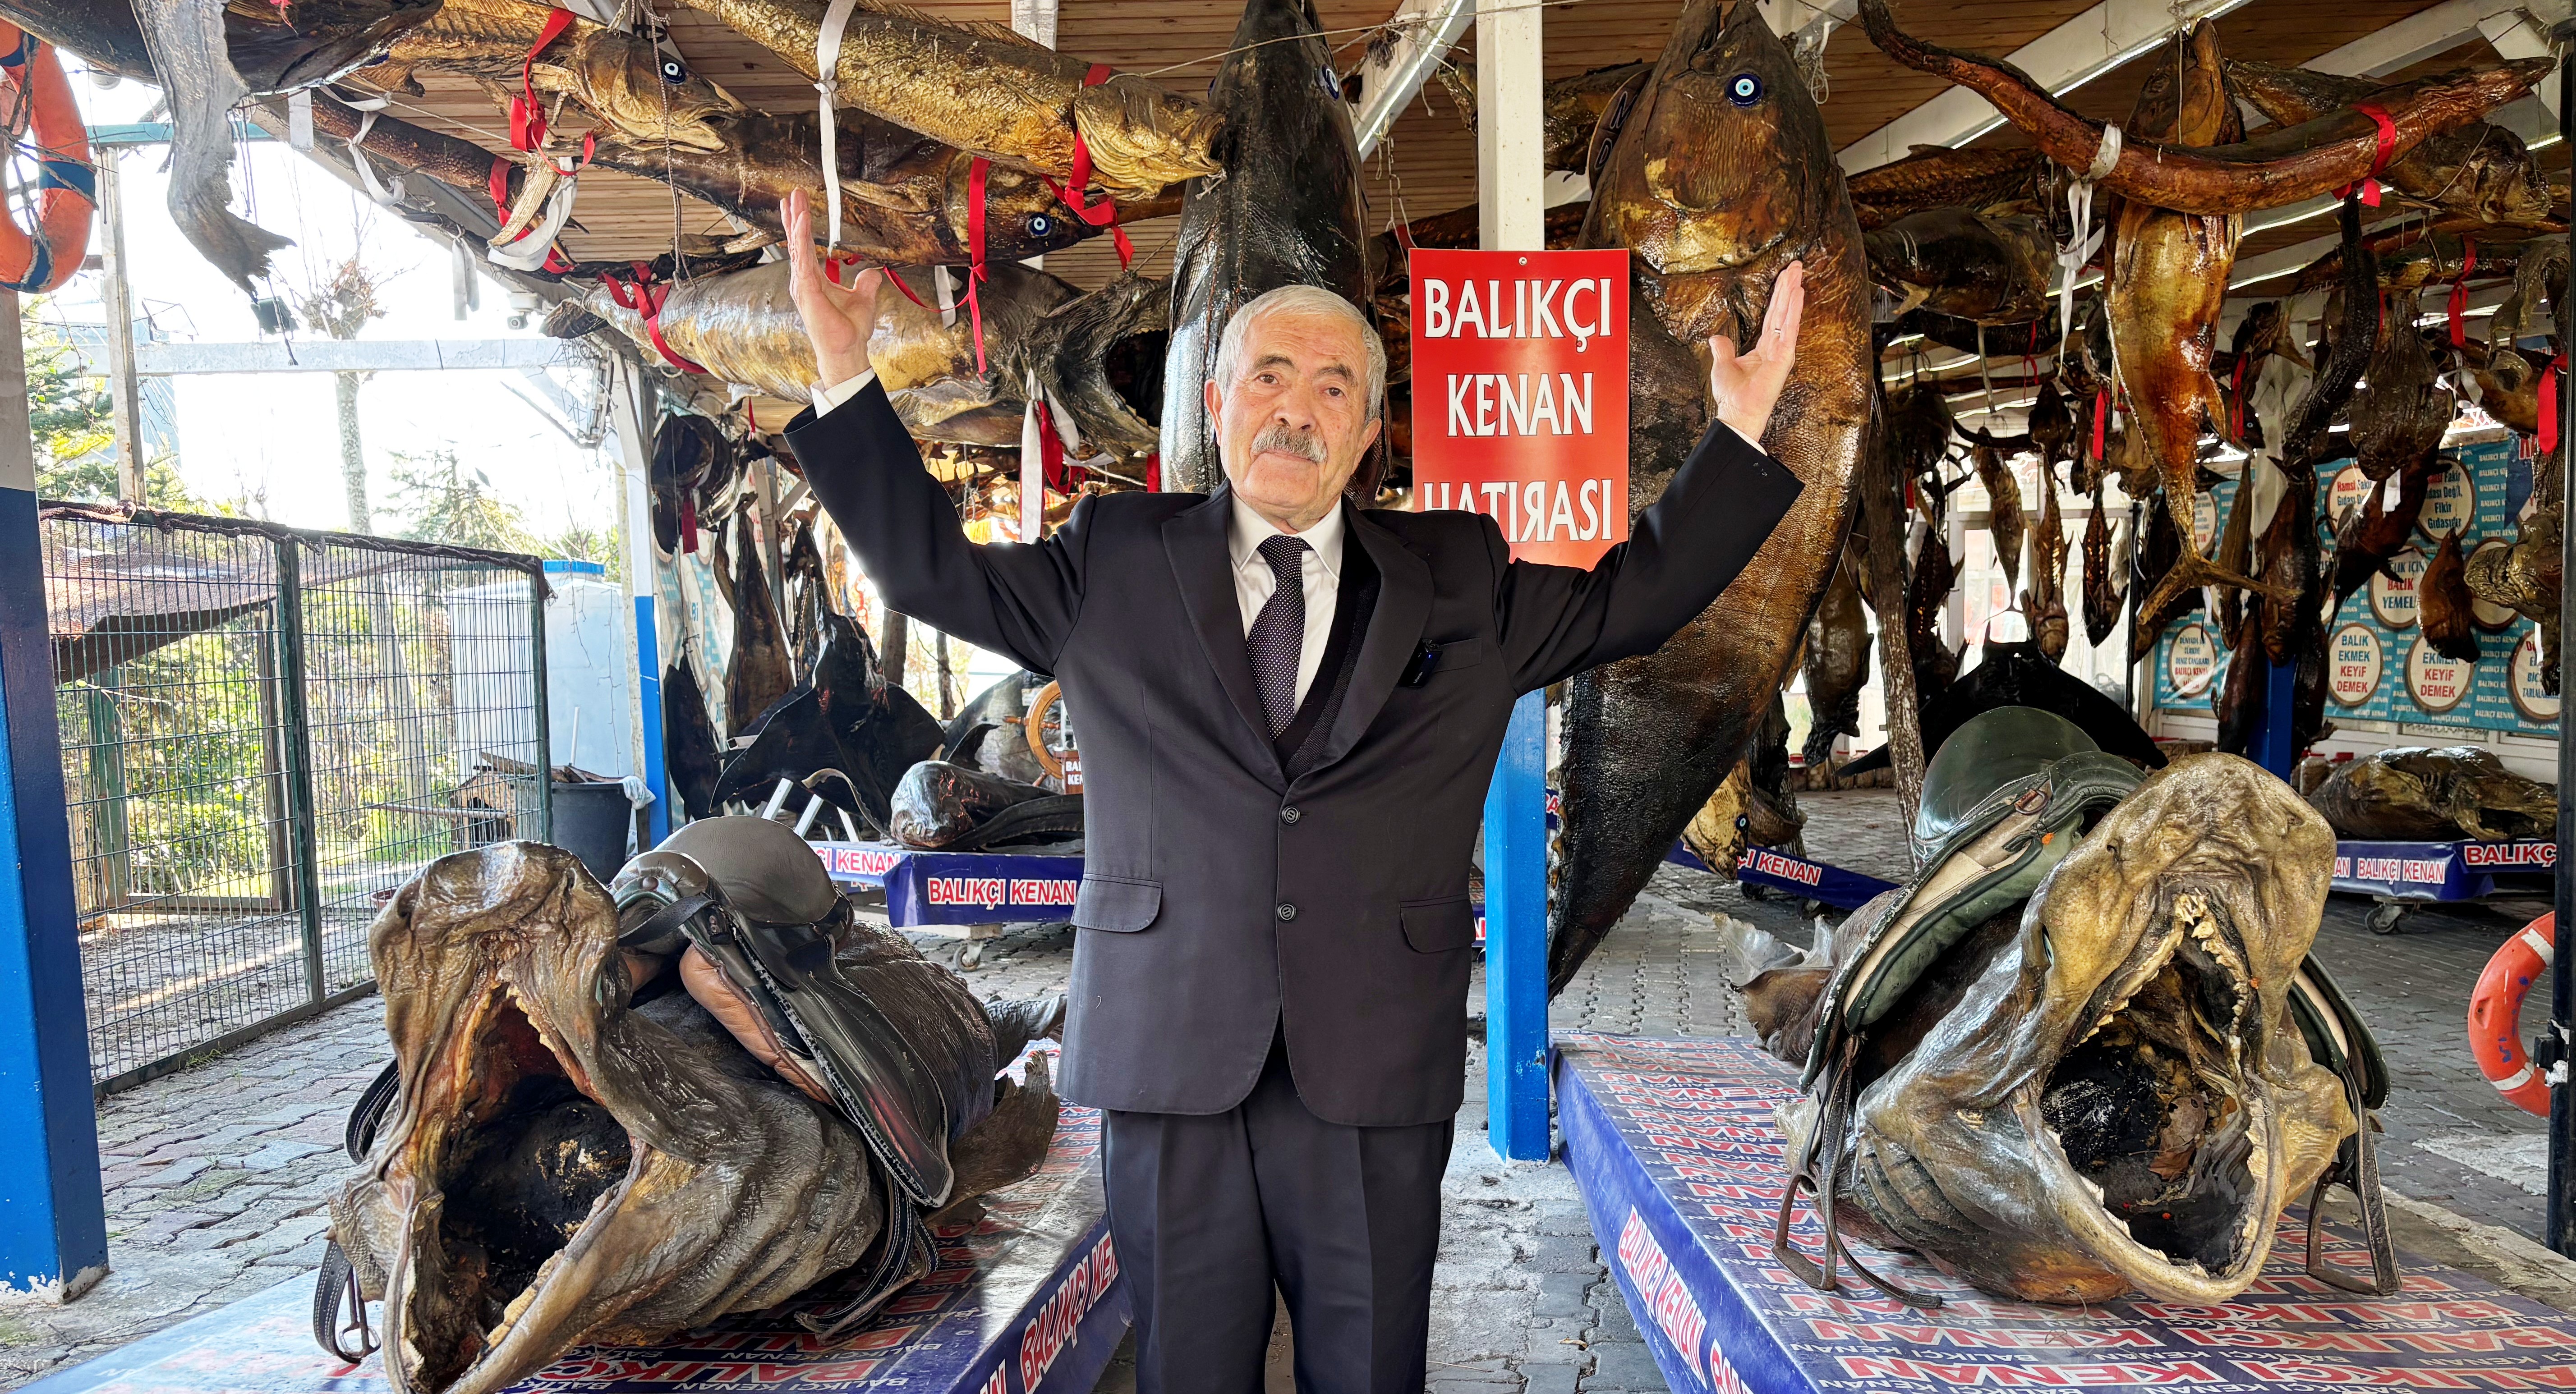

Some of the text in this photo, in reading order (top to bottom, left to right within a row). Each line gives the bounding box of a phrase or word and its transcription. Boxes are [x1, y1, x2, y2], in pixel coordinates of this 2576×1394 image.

[1423, 278, 1612, 353] BALIKÇI
[1447, 372, 1594, 437] KENAN
[2383, 596, 2416, 609] YEMEL
[2342, 635, 2369, 646] BALIK
[2338, 650, 2370, 662] EKMEK
[2337, 680, 2368, 693] DEMEK
[2420, 684, 2456, 698] DEMEK
[2464, 843, 2557, 867] BALIKÇ
[1756, 851, 1822, 886] KENAN
[2357, 858, 2401, 885] BALIKÇI
[2402, 859, 2446, 885] KENAN
[927, 877, 1078, 910] BALIKÇI KENAN
[1605, 1083, 1813, 1098] KENAN
[1618, 1204, 1708, 1390] BALIKÇI KENAN
[1020, 1255, 1089, 1394] BALIKÇI
[1802, 1318, 2167, 1349] KENAN
[1790, 1343, 2039, 1362] BALIKÇI KENAN
[2093, 1351, 2212, 1361] KENAN
[2416, 1356, 2539, 1366] KENAN
[538, 1360, 885, 1383] BALIKÇ
[1833, 1354, 2576, 1390] ALIKÇI KENAN
[672, 1378, 910, 1391] BALIKÇI KENAN
[1818, 1379, 1938, 1392] KENAN
